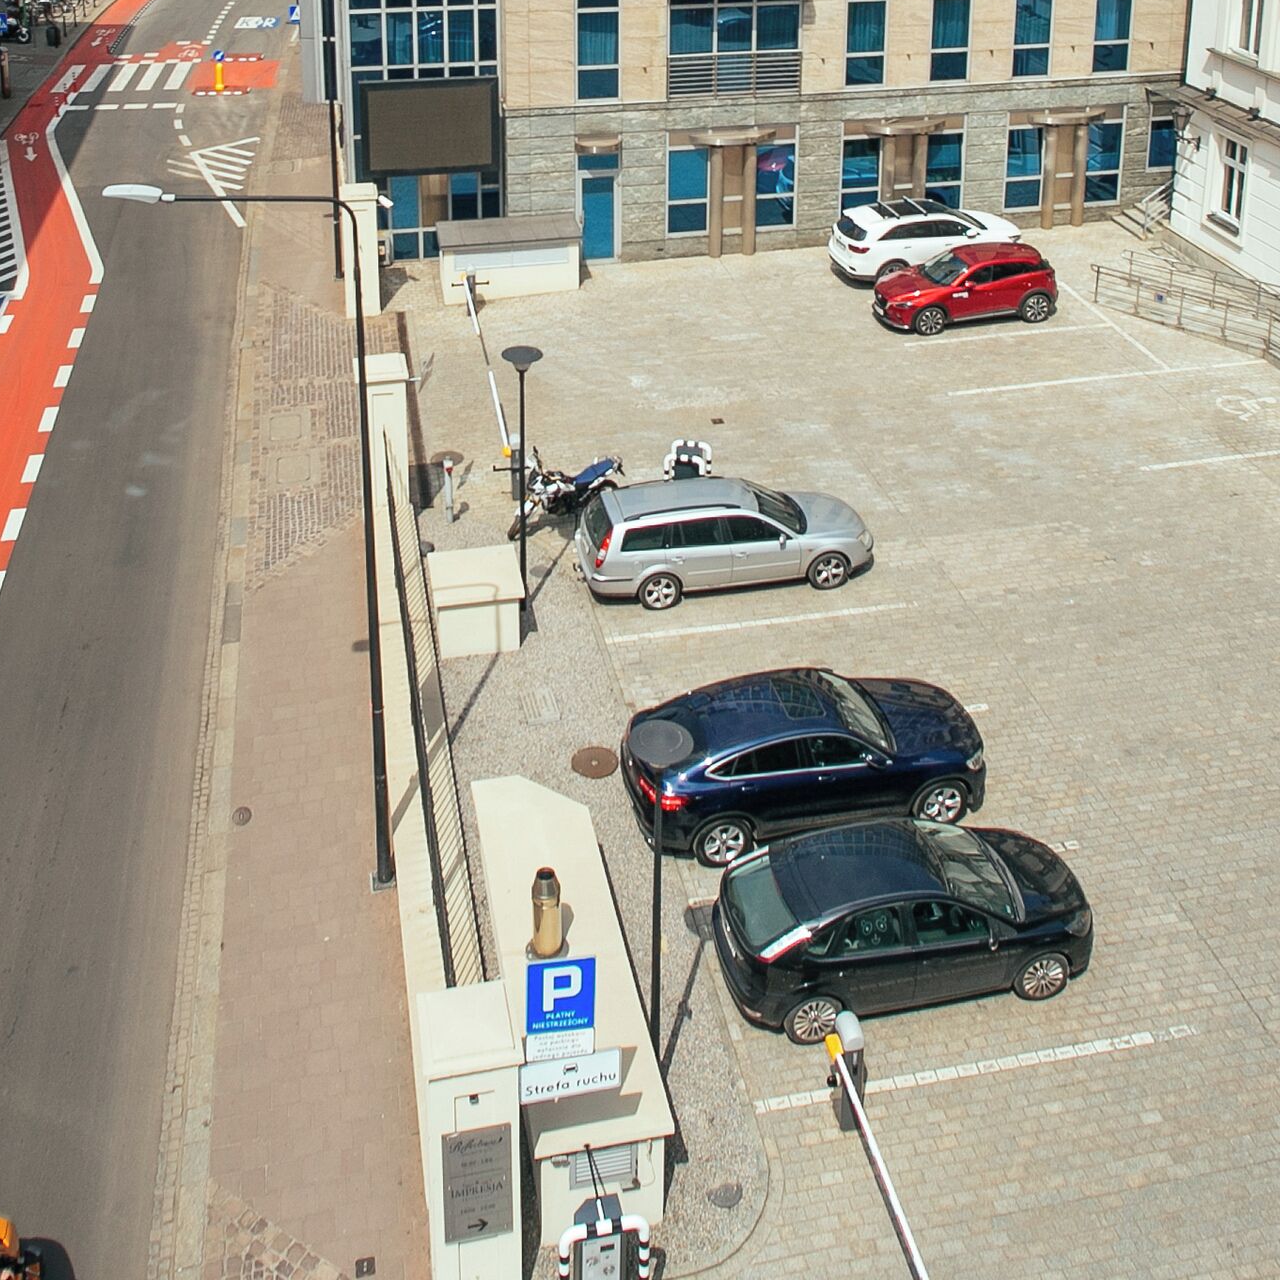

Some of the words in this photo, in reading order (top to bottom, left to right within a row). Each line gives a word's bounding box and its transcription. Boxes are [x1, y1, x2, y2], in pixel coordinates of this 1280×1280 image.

[542, 965, 583, 1013] P
[525, 1079, 570, 1097] Strefa
[576, 1071, 616, 1087] ruchu
